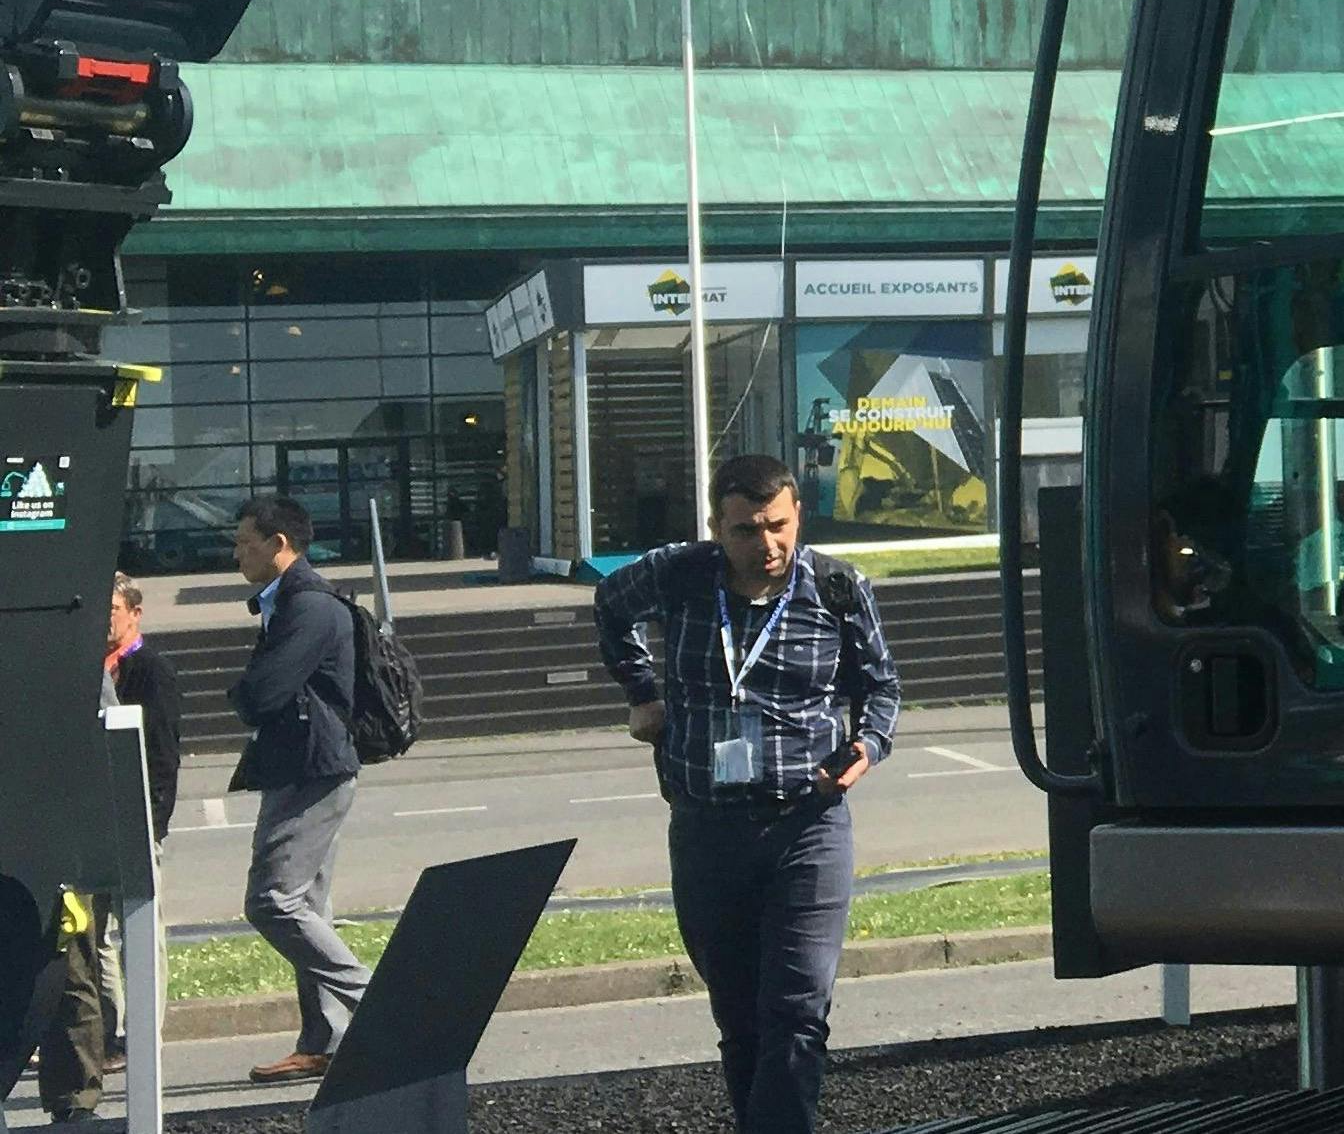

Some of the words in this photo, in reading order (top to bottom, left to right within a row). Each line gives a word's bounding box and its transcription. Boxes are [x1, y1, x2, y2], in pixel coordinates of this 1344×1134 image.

[804, 283, 876, 295] ACCUEIL
[880, 282, 978, 294] EXPOSANTS
[857, 397, 926, 410] DEMAIN
[829, 409, 850, 422] SE
[856, 405, 955, 422] CONSTRUIT
